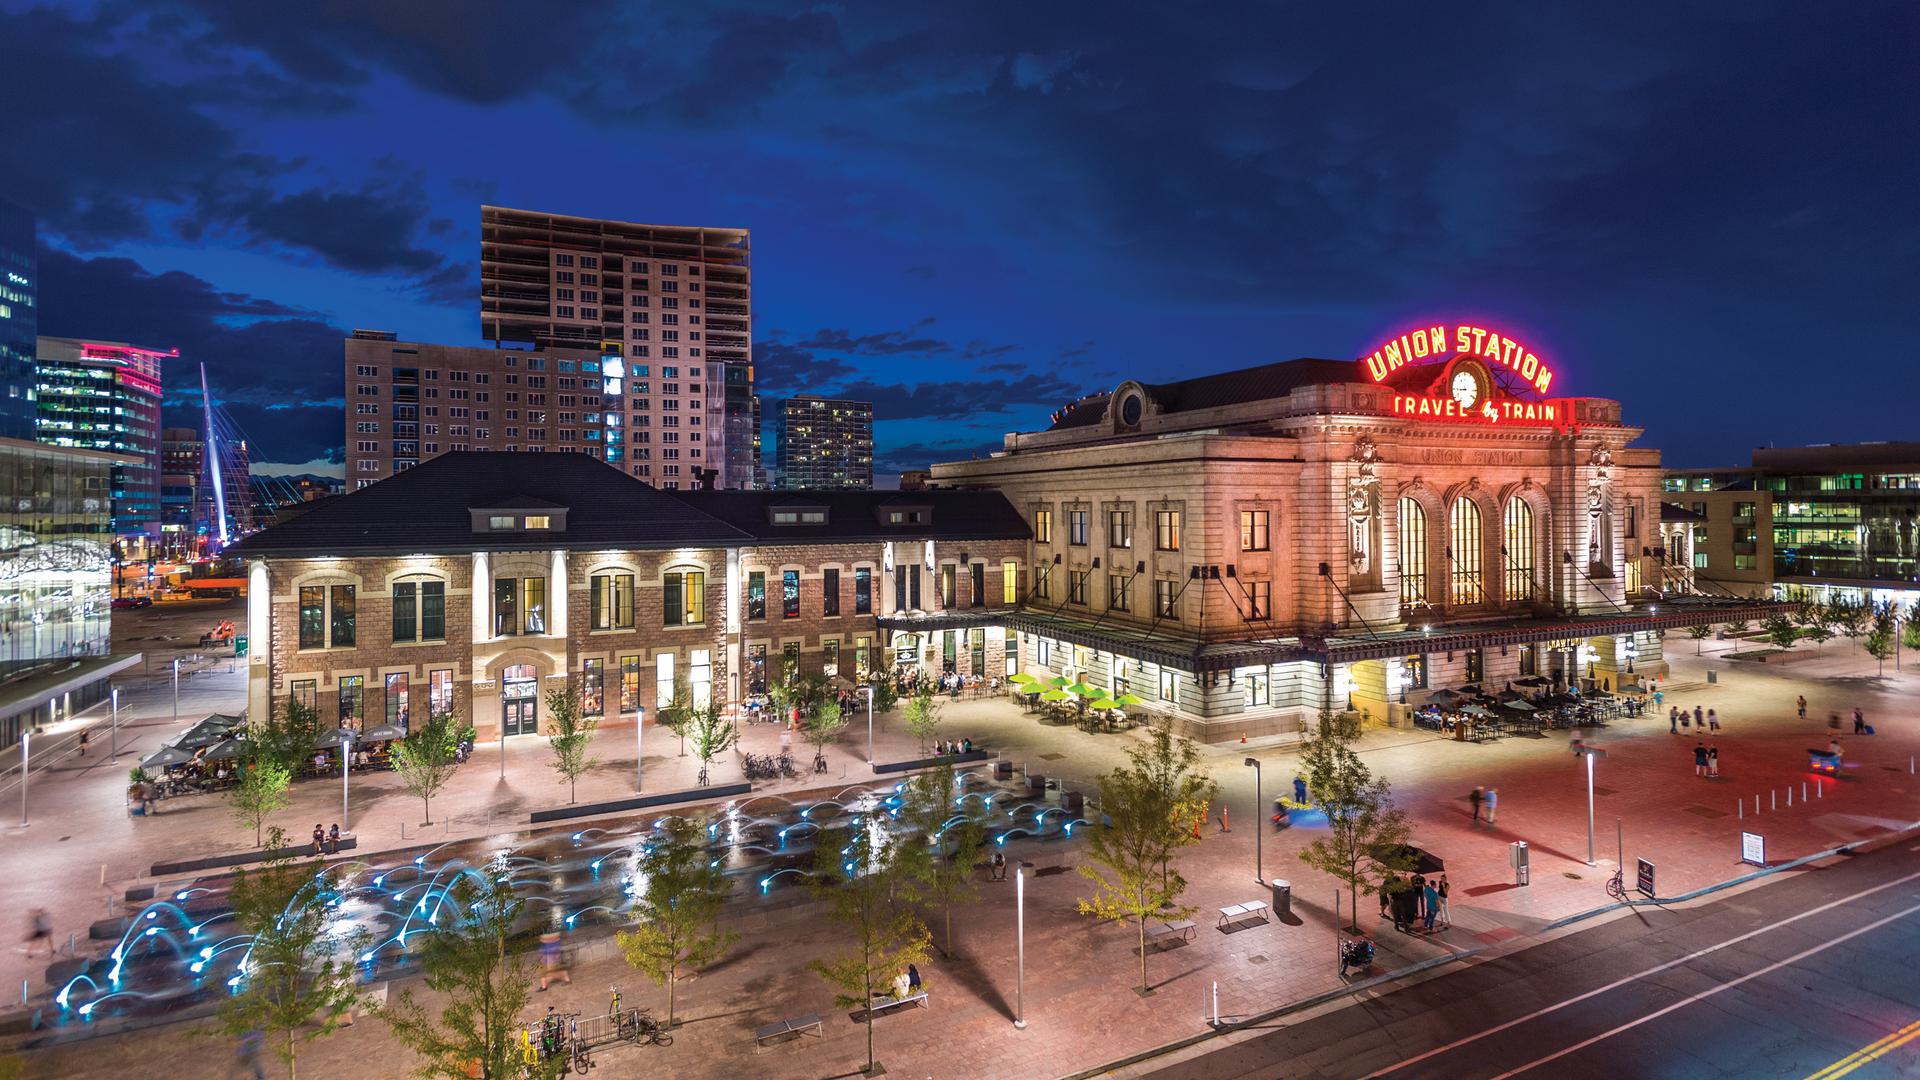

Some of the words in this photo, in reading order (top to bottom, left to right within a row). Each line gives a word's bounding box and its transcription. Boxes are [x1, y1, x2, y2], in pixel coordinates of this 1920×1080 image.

[1367, 326, 1446, 381] UNION
[1457, 326, 1552, 394] STATION
[1394, 396, 1468, 416] TRAVEL
[1482, 400, 1499, 423] by
[1502, 402, 1554, 420] TRAIN
[1421, 448, 1463, 464] UNION
[1472, 450, 1522, 465] STATION
